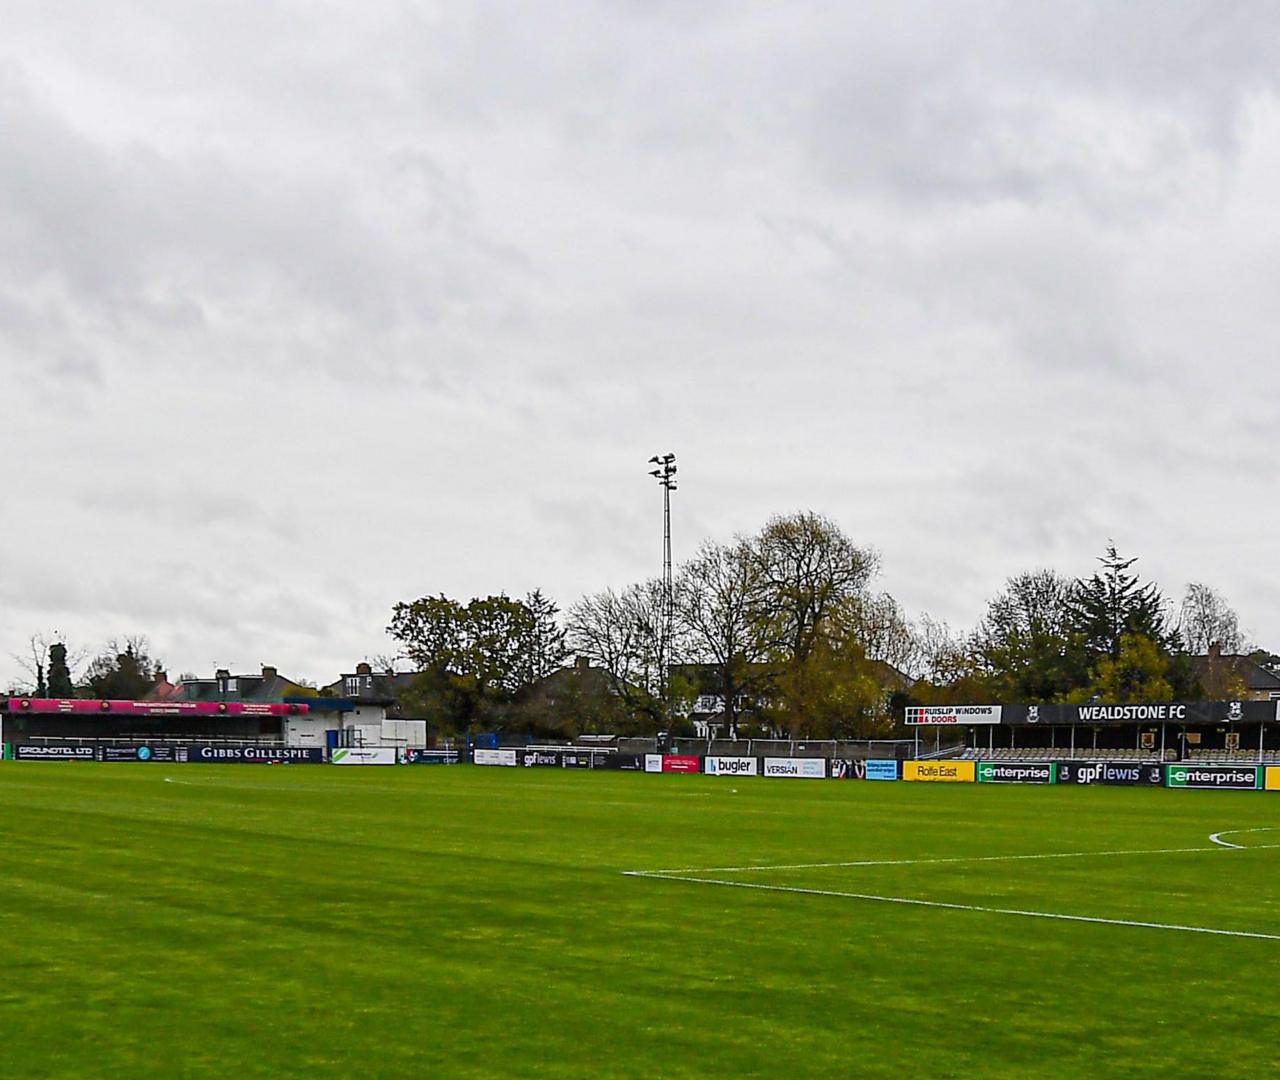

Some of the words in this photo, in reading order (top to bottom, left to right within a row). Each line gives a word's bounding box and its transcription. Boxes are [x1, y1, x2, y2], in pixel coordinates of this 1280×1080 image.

[924, 707, 954, 715] RUISLIP
[1079, 705, 1166, 720] WEALDSTONE
[1169, 705, 1186, 719] FC
[201, 747, 241, 758] GIBBS
[244, 748, 310, 759] GILLESPIE
[718, 758, 751, 773] bugler
[917, 766, 938, 777] Rolfe
[939, 766, 957, 777] East
[984, 766, 1049, 779] enterprise
[1175, 770, 1255, 785] enterprise
